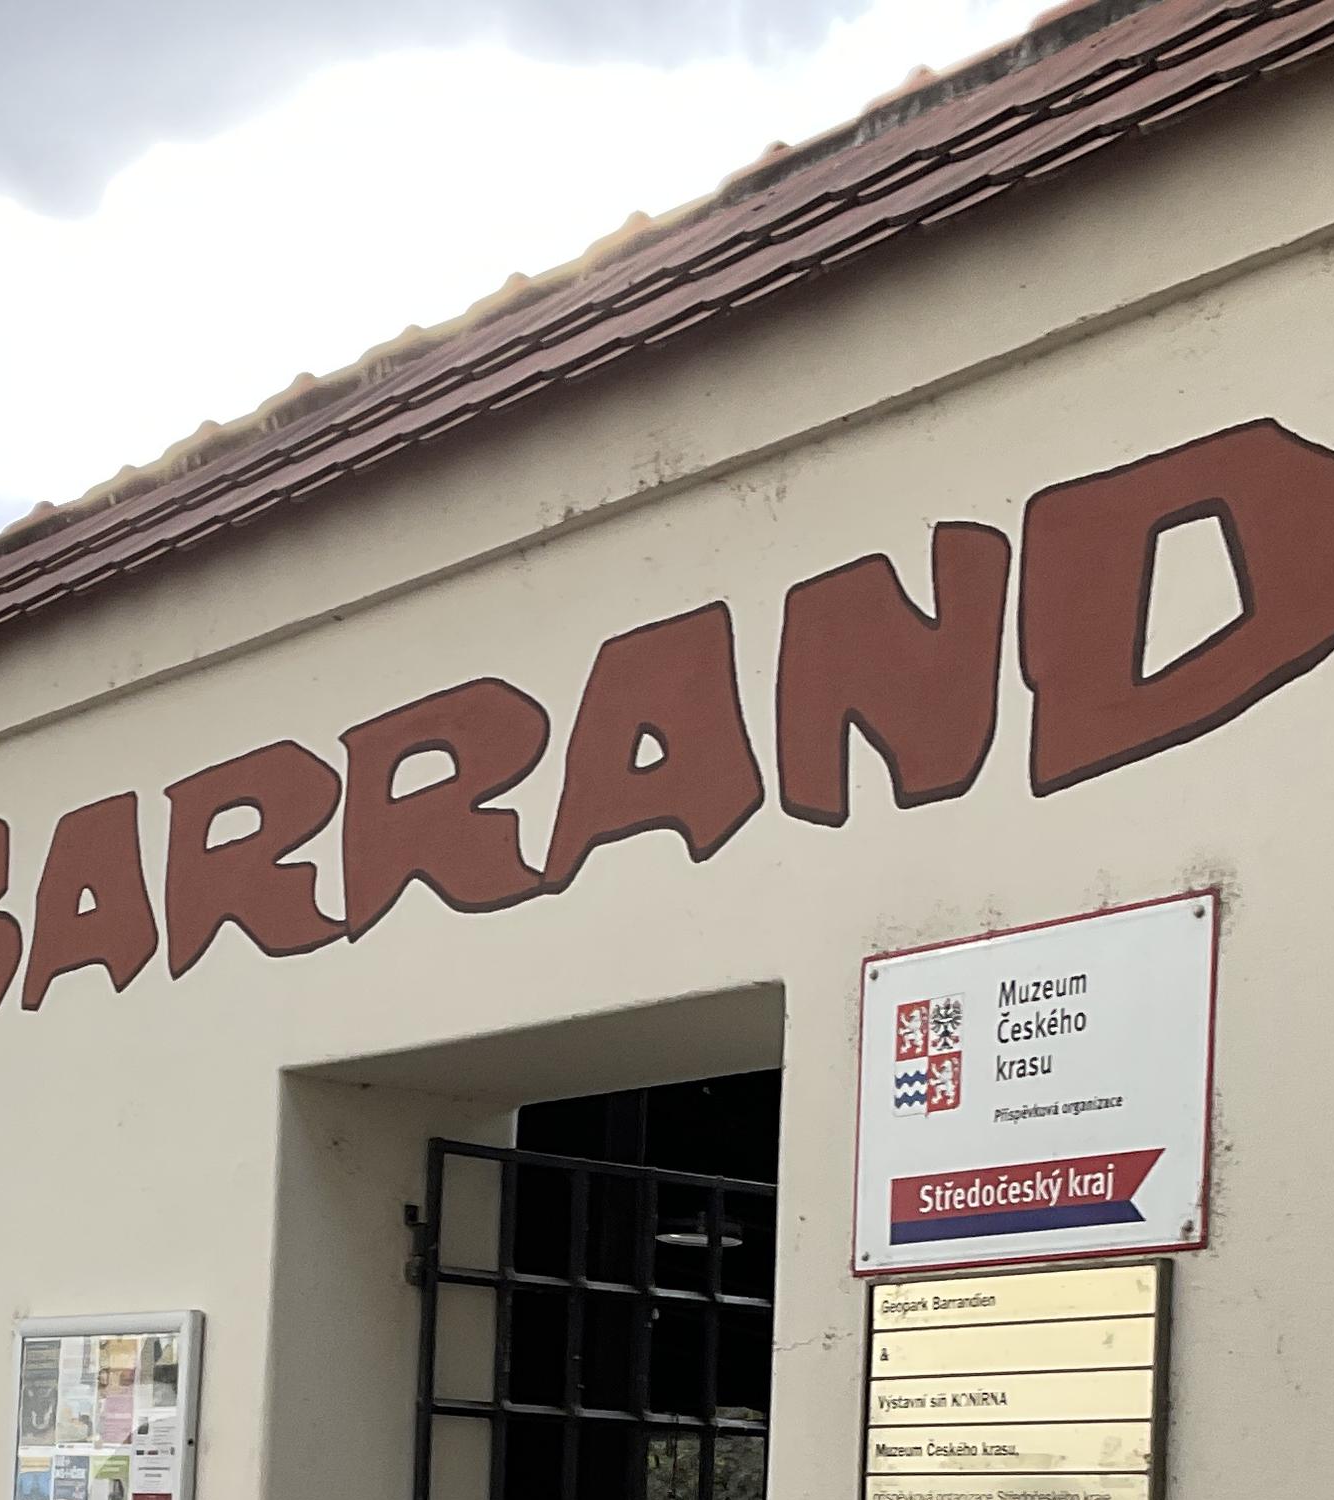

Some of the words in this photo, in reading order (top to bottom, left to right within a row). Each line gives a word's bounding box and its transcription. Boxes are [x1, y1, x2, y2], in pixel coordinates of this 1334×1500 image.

[998, 973, 1087, 1008] Muzeum
[997, 1009, 1087, 1044] Českého
[996, 1052, 1053, 1082] krasu
[1062, 1096, 1123, 1115] organizace
[918, 1168, 1062, 1213] Středočeský
[1068, 1164, 1115, 1202] kraj
[881, 1297, 928, 1319] Geopark
[932, 1292, 996, 1310] Barrandien
[875, 1443, 923, 1457] Muzeum
[927, 1439, 978, 1457] Českého
